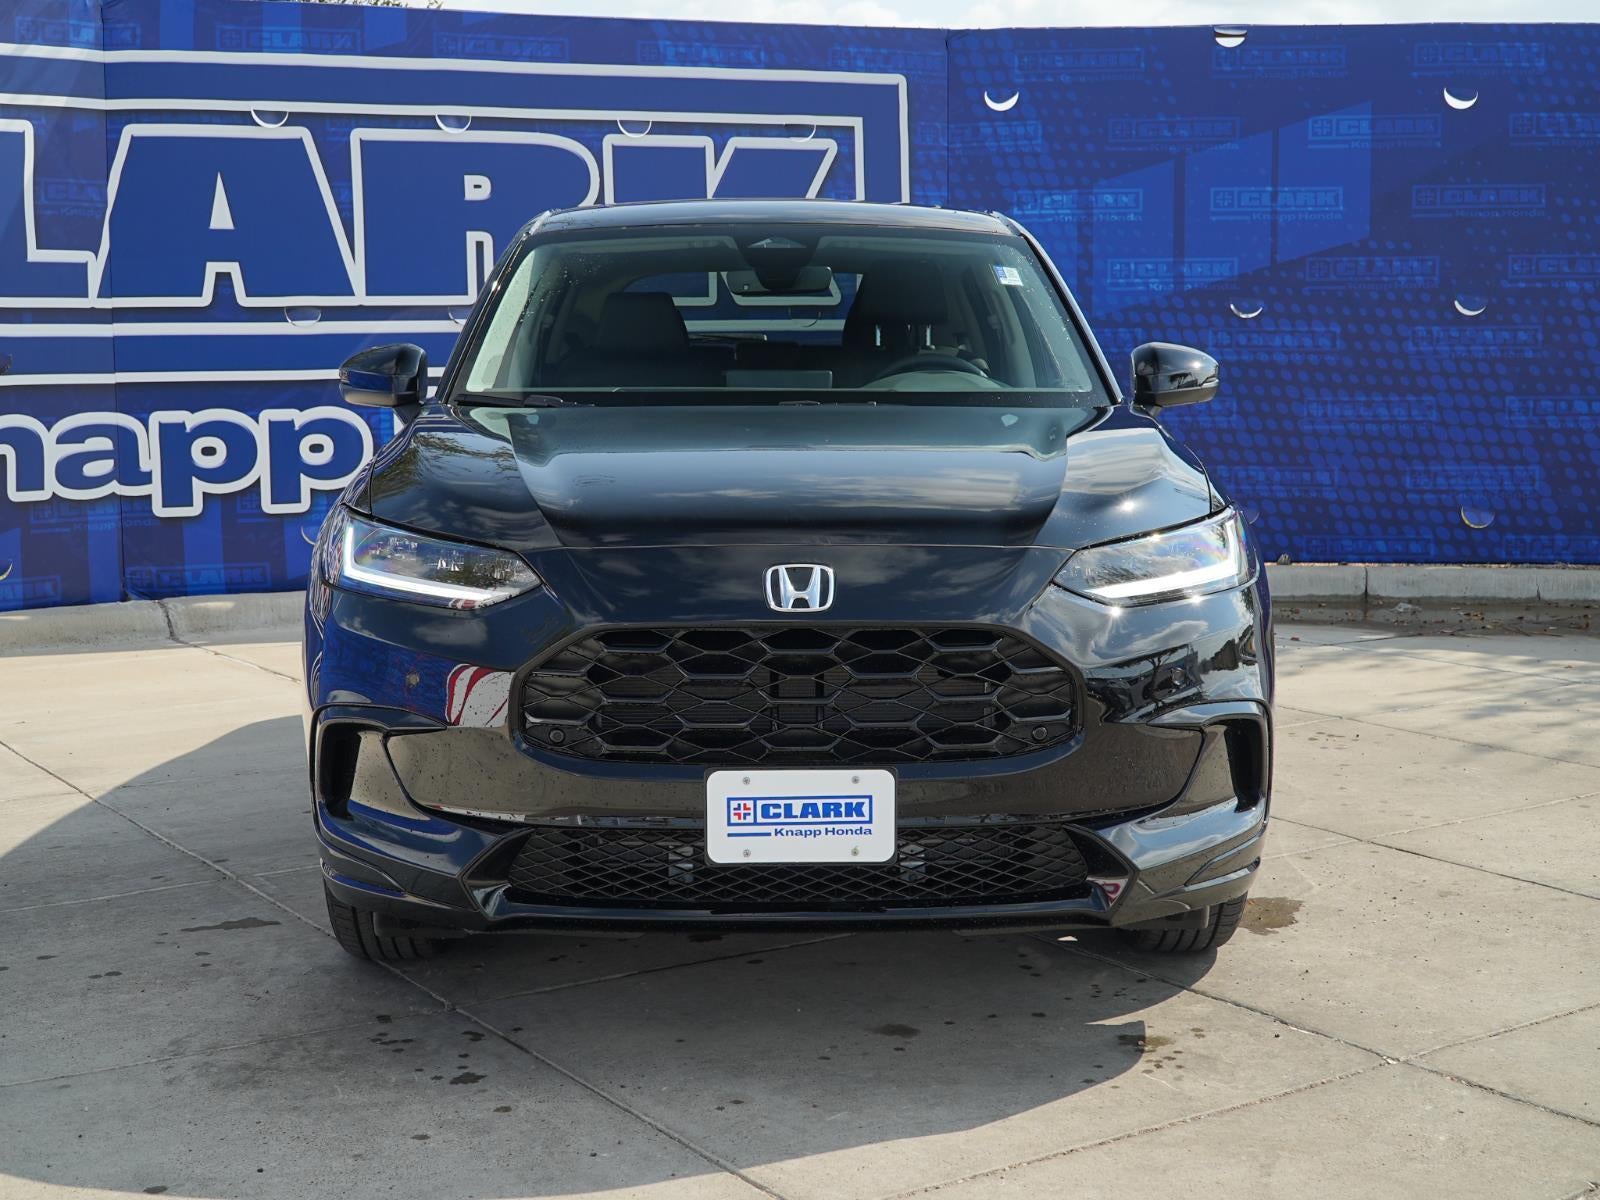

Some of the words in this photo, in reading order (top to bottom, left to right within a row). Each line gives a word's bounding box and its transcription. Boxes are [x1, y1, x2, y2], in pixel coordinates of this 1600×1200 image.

[1338, 118, 1435, 135] CLARK
[1240, 191, 1338, 206] CLARK
[1442, 189, 1538, 203] CLARK
[760, 801, 866, 820] CLARK
[774, 827, 822, 838] Knapp
[824, 826, 872, 837] Honda
